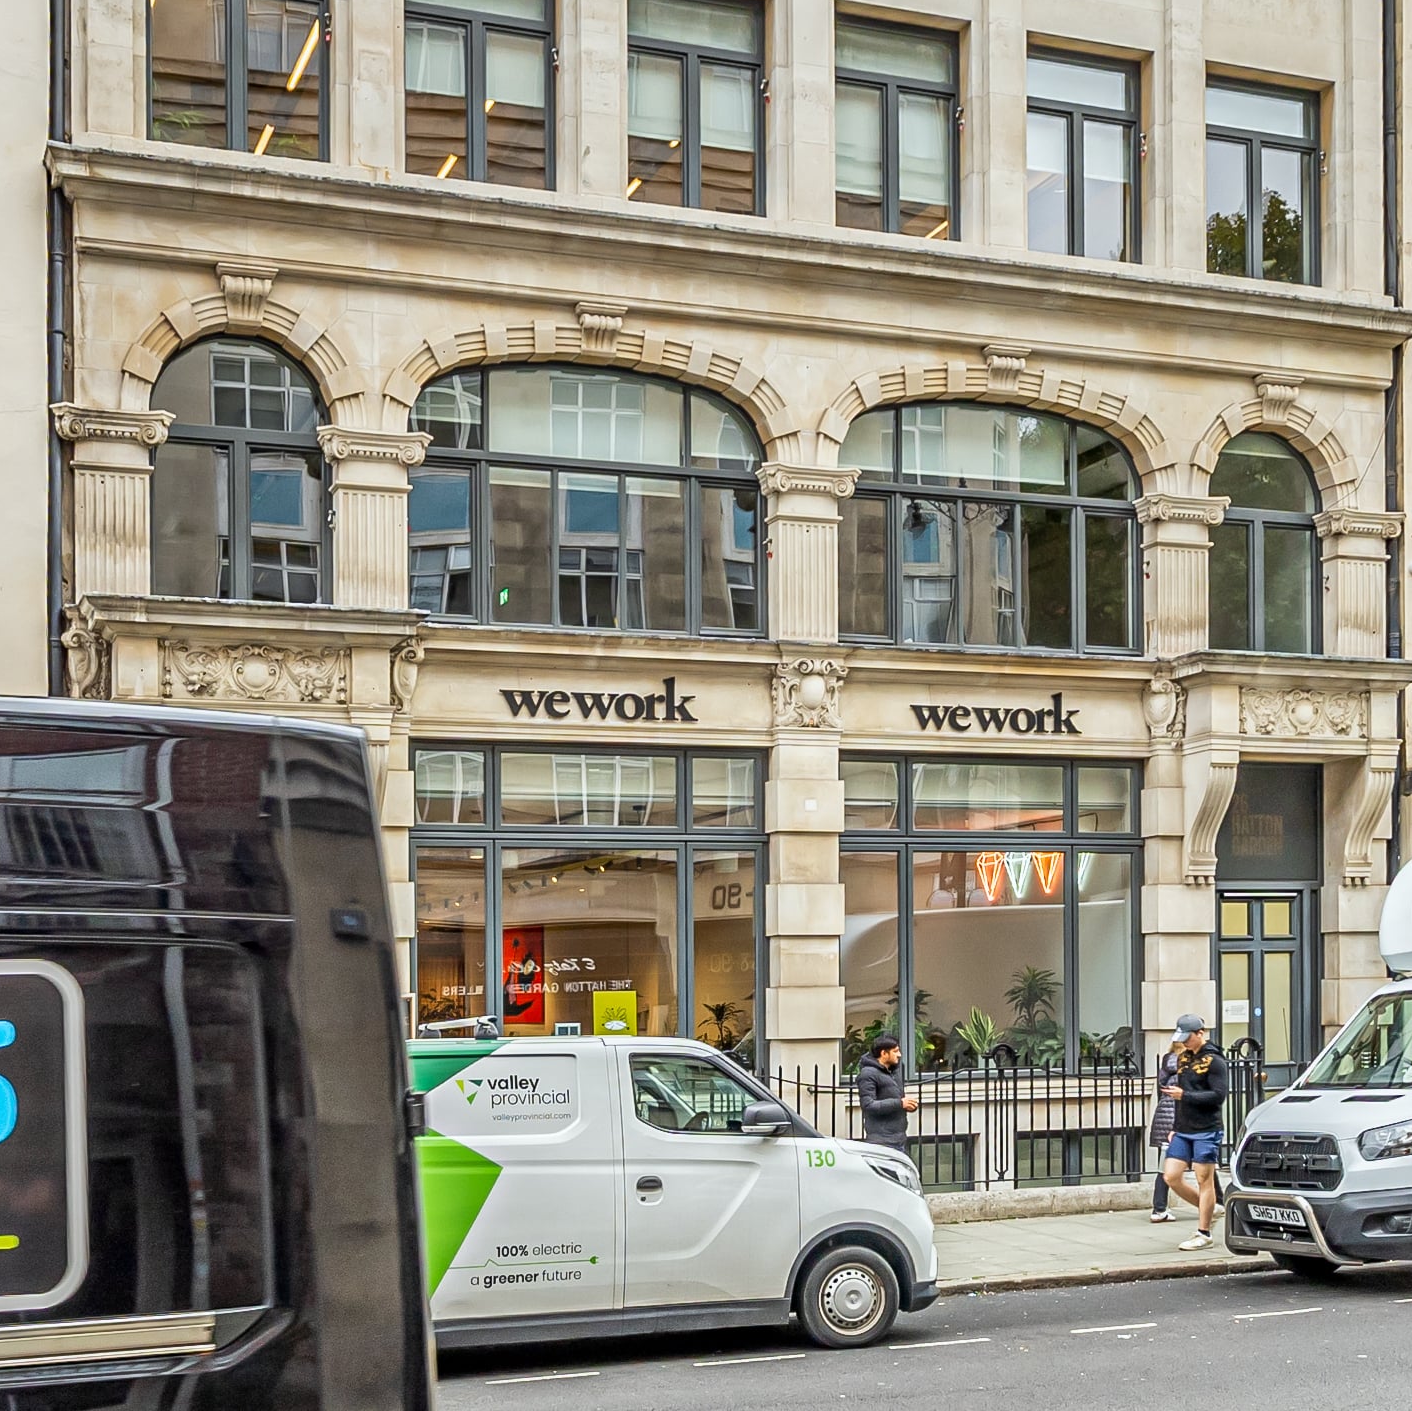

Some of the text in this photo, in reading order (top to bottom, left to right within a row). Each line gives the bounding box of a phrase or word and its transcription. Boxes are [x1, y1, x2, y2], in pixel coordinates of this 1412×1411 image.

[499, 676, 699, 723] wework
[909, 691, 1083, 735] wework
[487, 1075, 540, 1092] valley
[491, 1089, 570, 1109] provincial
[492, 1112, 572, 1123] valleyprovincial.com
[805, 1149, 836, 1168] 130
[1252, 1205, 1279, 1222] SH67
[496, 1241, 582, 1258] 100% electric
[470, 1268, 582, 1288] a greener future
